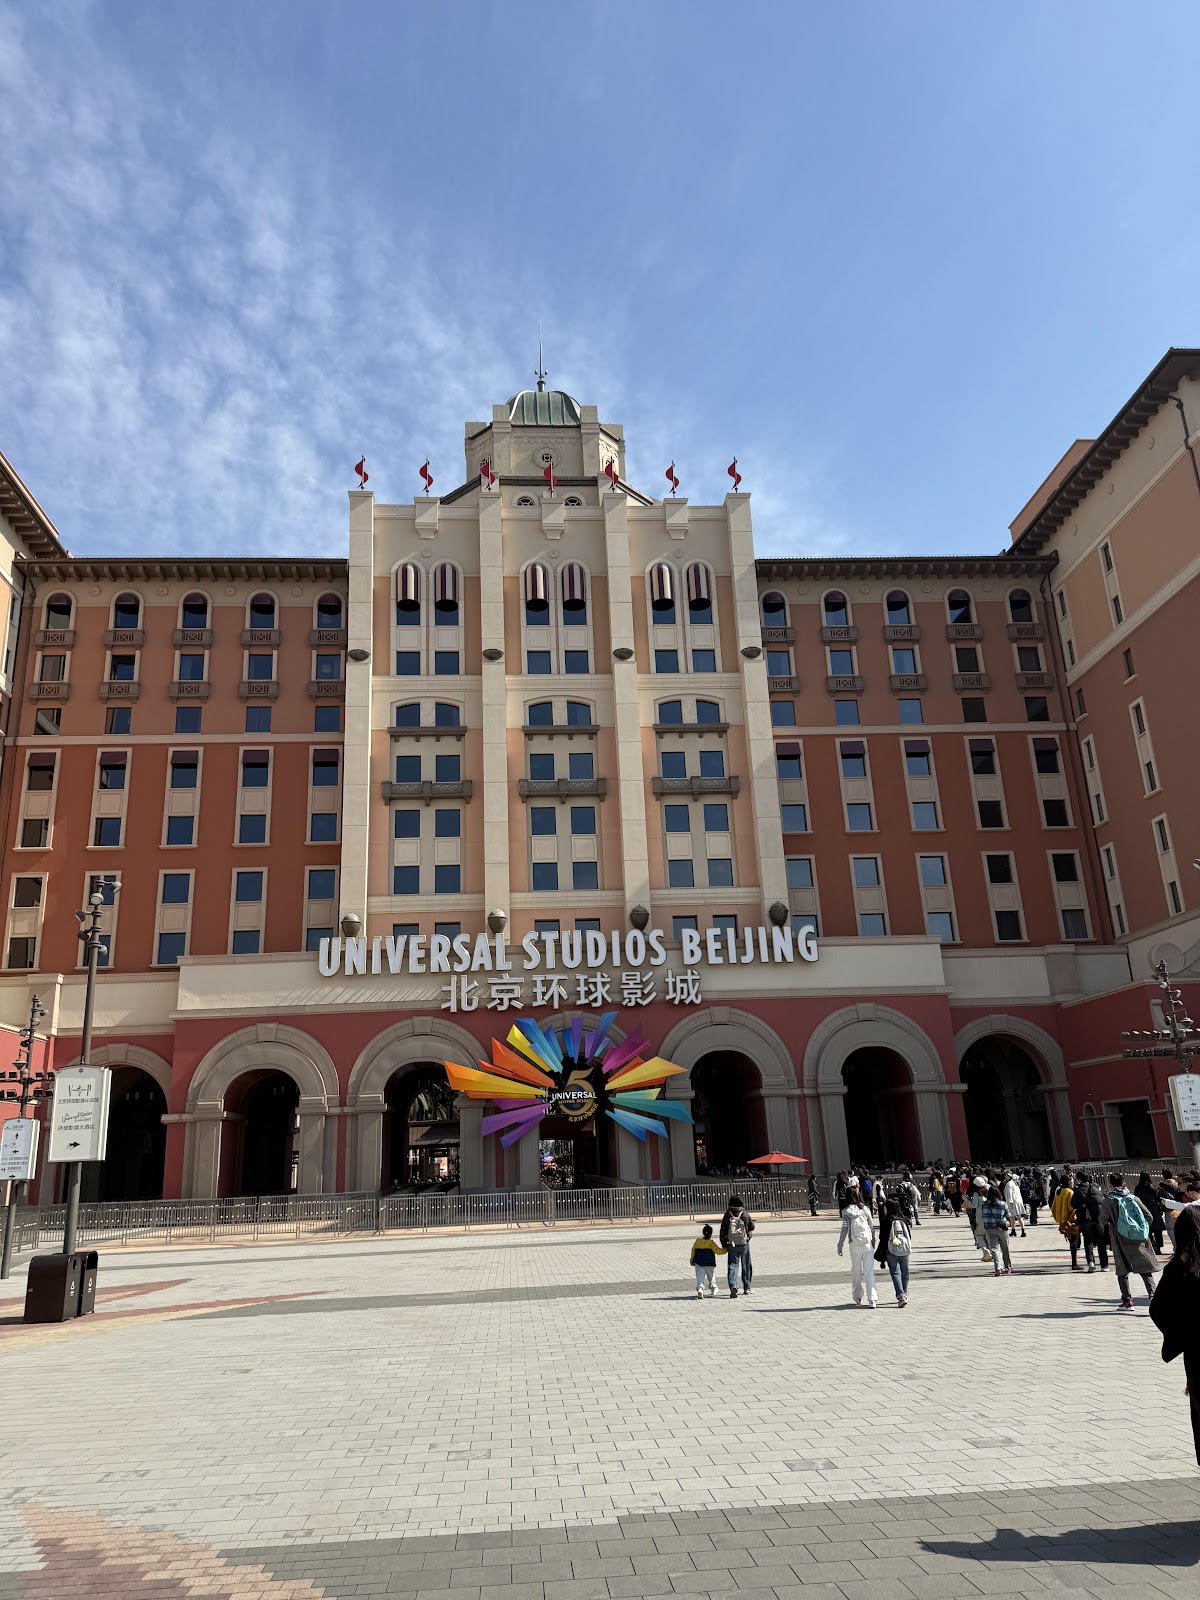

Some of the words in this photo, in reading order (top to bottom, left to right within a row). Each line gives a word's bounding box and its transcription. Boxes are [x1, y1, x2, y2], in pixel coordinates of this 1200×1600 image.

[318, 932, 512, 977] UNIVERSAL
[522, 928, 668, 970] STUDIOS
[681, 924, 820, 966] BEIJING
[440, 969, 702, 1012] 北京环球影城
[551, 1091, 597, 1100] UNIVERSAL
